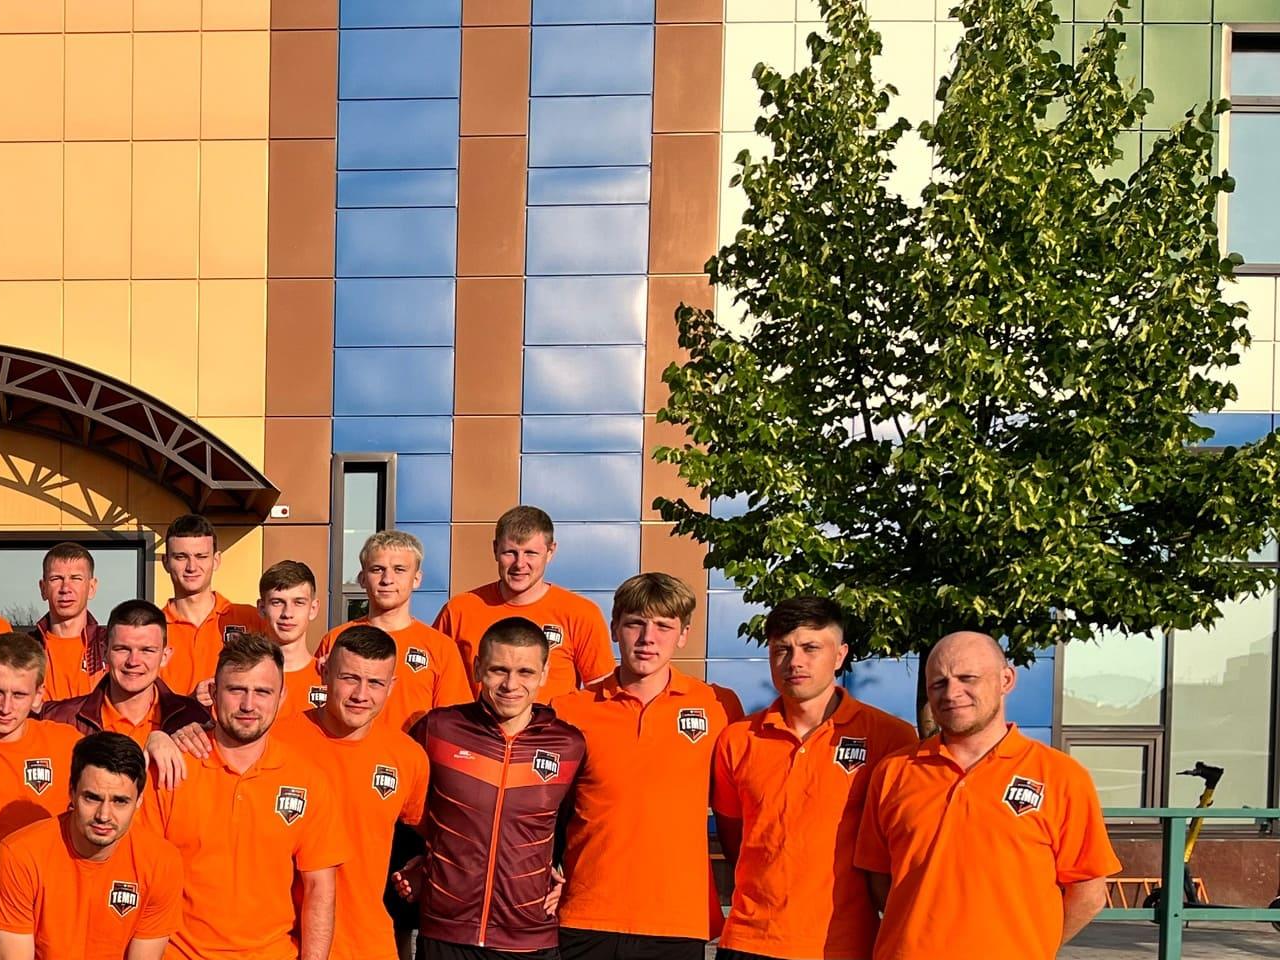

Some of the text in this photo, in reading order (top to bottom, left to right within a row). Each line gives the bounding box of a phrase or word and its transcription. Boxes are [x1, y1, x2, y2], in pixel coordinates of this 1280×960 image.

[679, 718, 704, 730] ТЕМП
[839, 747, 866, 761] ТЕМП
[535, 758, 557, 773] ТЕМП
[26, 768, 51, 780] ТЕМП
[375, 774, 396, 789] ТЕМП
[1008, 787, 1041, 807] ТЕМП
[279, 797, 304, 812] ТЕМП
[112, 891, 136, 905] ТЕМП
